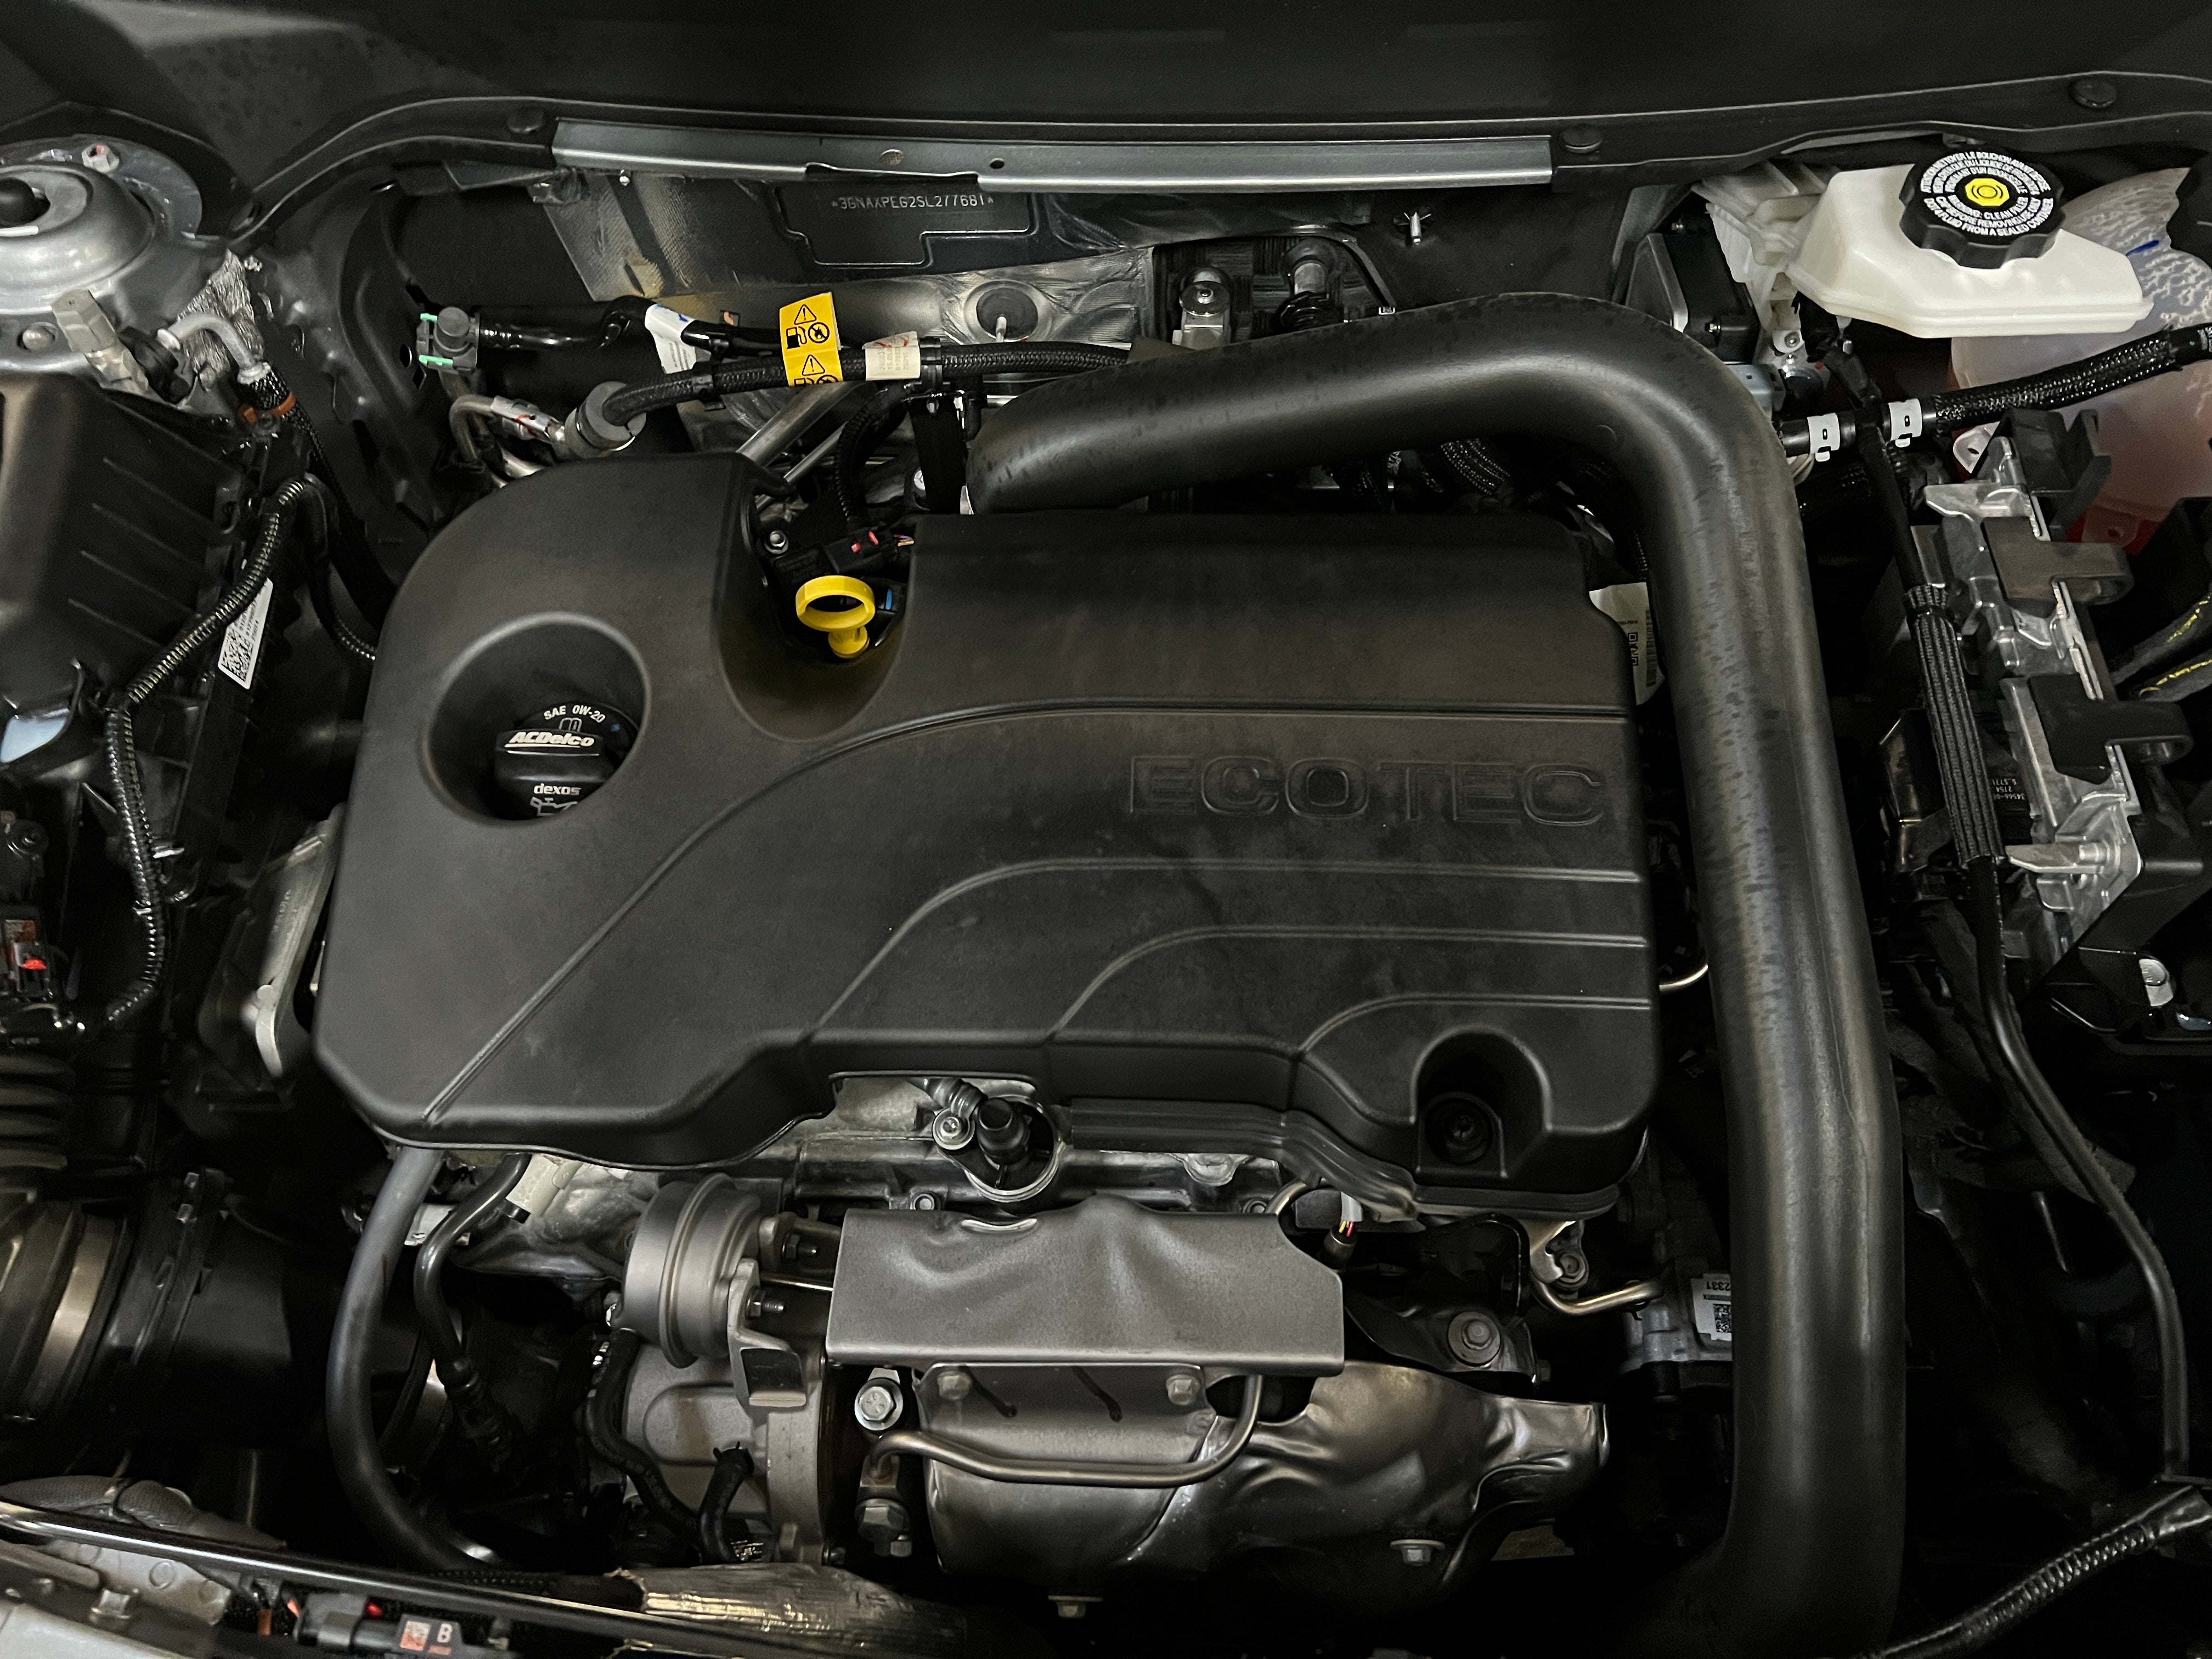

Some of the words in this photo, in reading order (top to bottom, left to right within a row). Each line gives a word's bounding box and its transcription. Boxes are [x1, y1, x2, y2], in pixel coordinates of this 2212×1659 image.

[1984, 210, 2013, 220] CLEAN
[2009, 196, 2029, 216] FILLER
[1937, 211, 1963, 228] FLUID
[1961, 222, 1989, 235] FROM
[1989, 228, 1997, 236] A
[1996, 223, 2030, 236] SEALED
[543, 705, 567, 720] SAE
[572, 704, 606, 723] 0W-20
[509, 731, 595, 747] ACDelco
[533, 783, 582, 796] dexos
[1130, 755, 1604, 826] ECOTEC
